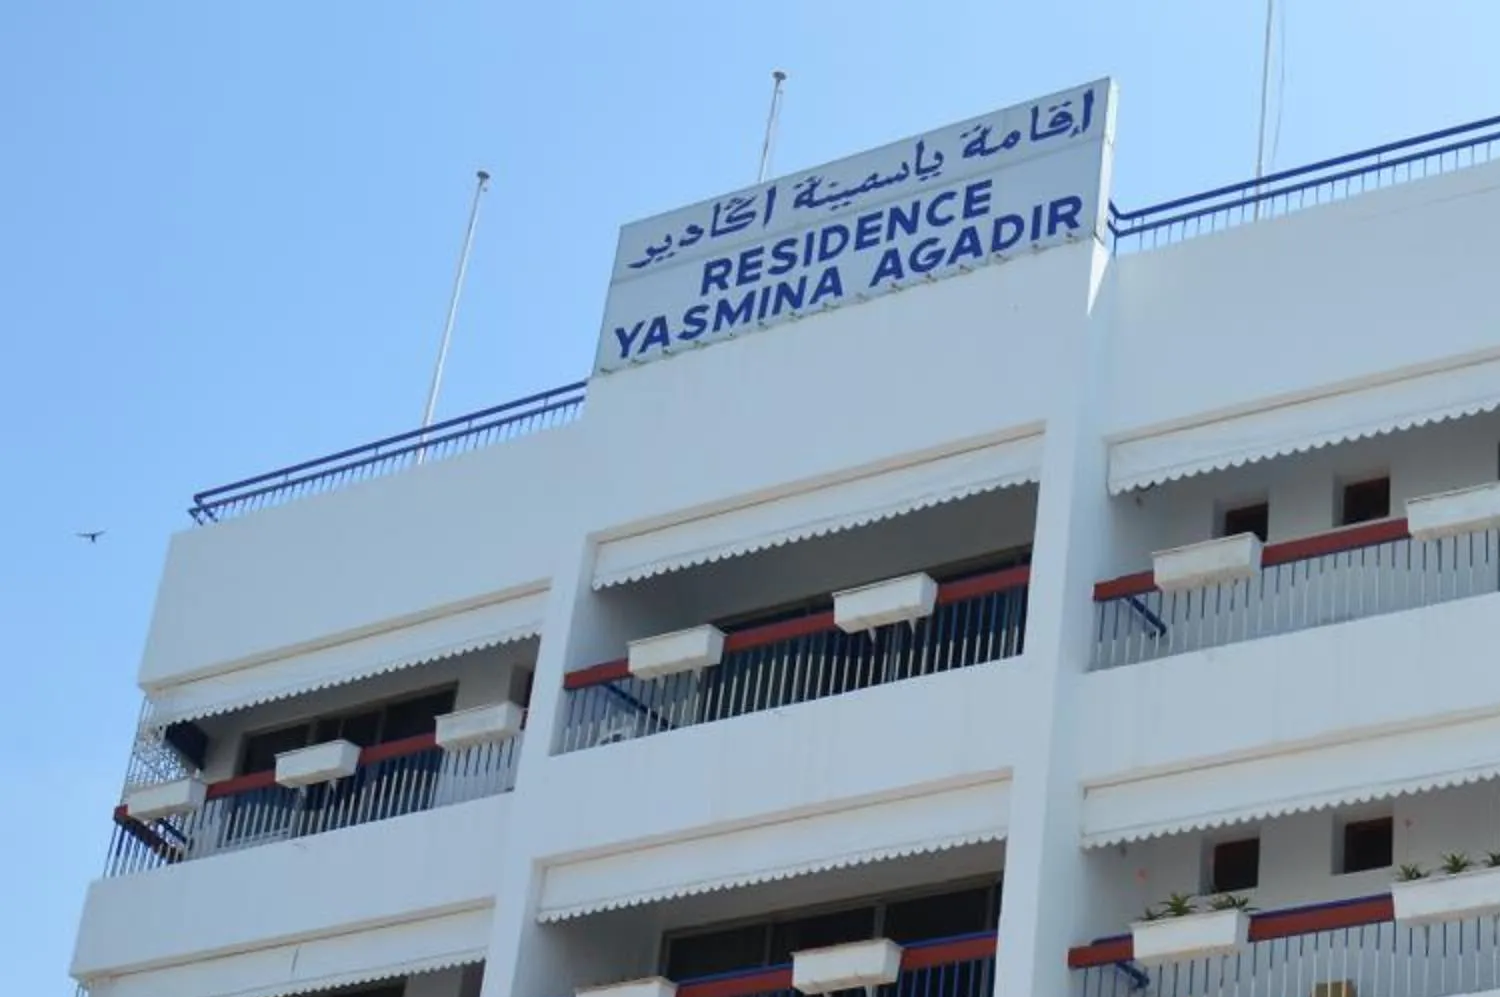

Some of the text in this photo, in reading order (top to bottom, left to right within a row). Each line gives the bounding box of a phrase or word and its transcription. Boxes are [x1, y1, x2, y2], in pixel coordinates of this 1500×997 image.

[793, 140, 944, 210] ياسمينة
[615, 196, 1082, 359] YASMINA AGADIR
[701, 180, 993, 296] RESIDENCE
